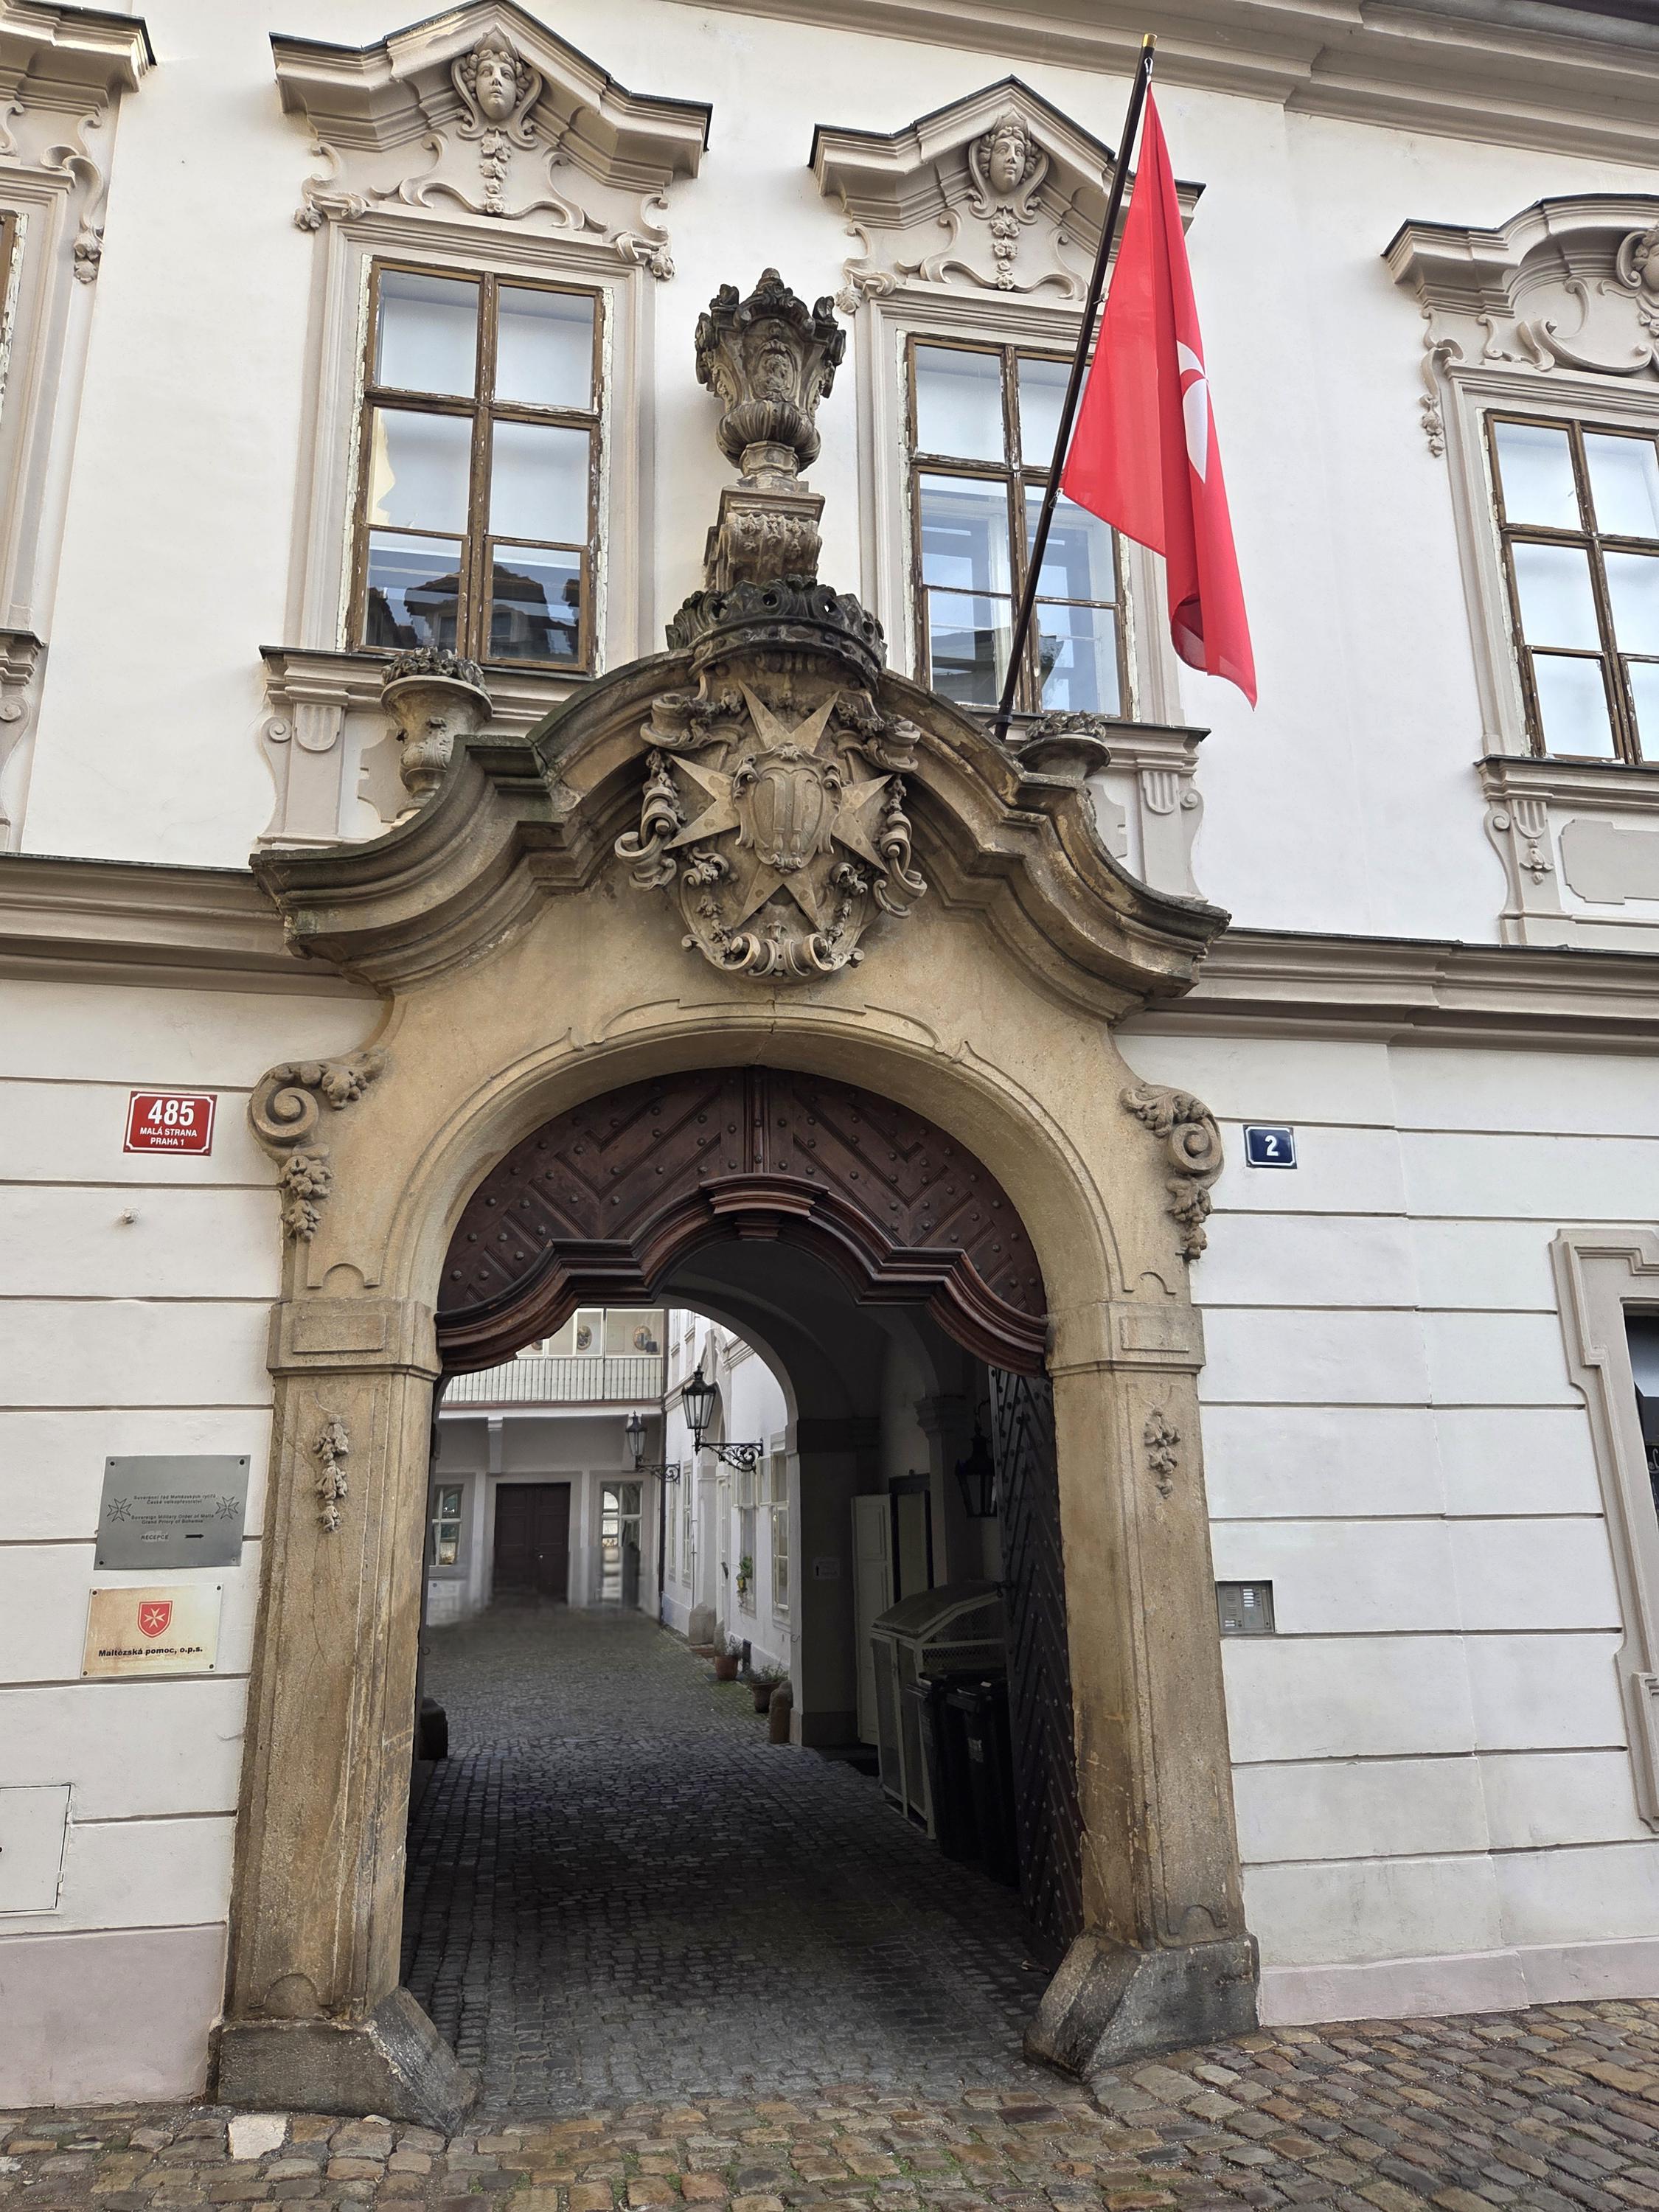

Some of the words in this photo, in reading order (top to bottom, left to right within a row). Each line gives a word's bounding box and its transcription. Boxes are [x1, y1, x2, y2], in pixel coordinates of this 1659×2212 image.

[147, 1099, 195, 1126] 485
[139, 1126, 163, 1135] MALÁ
[164, 1128, 198, 1137] STRANA
[150, 1137, 178, 1146] PRAHA
[1265, 1135, 1279, 1157] 2
[98, 1648, 143, 1657] Maltézská
[145, 1647, 177, 1656] pomoc,
[179, 1646, 203, 1654] o.p.s.
